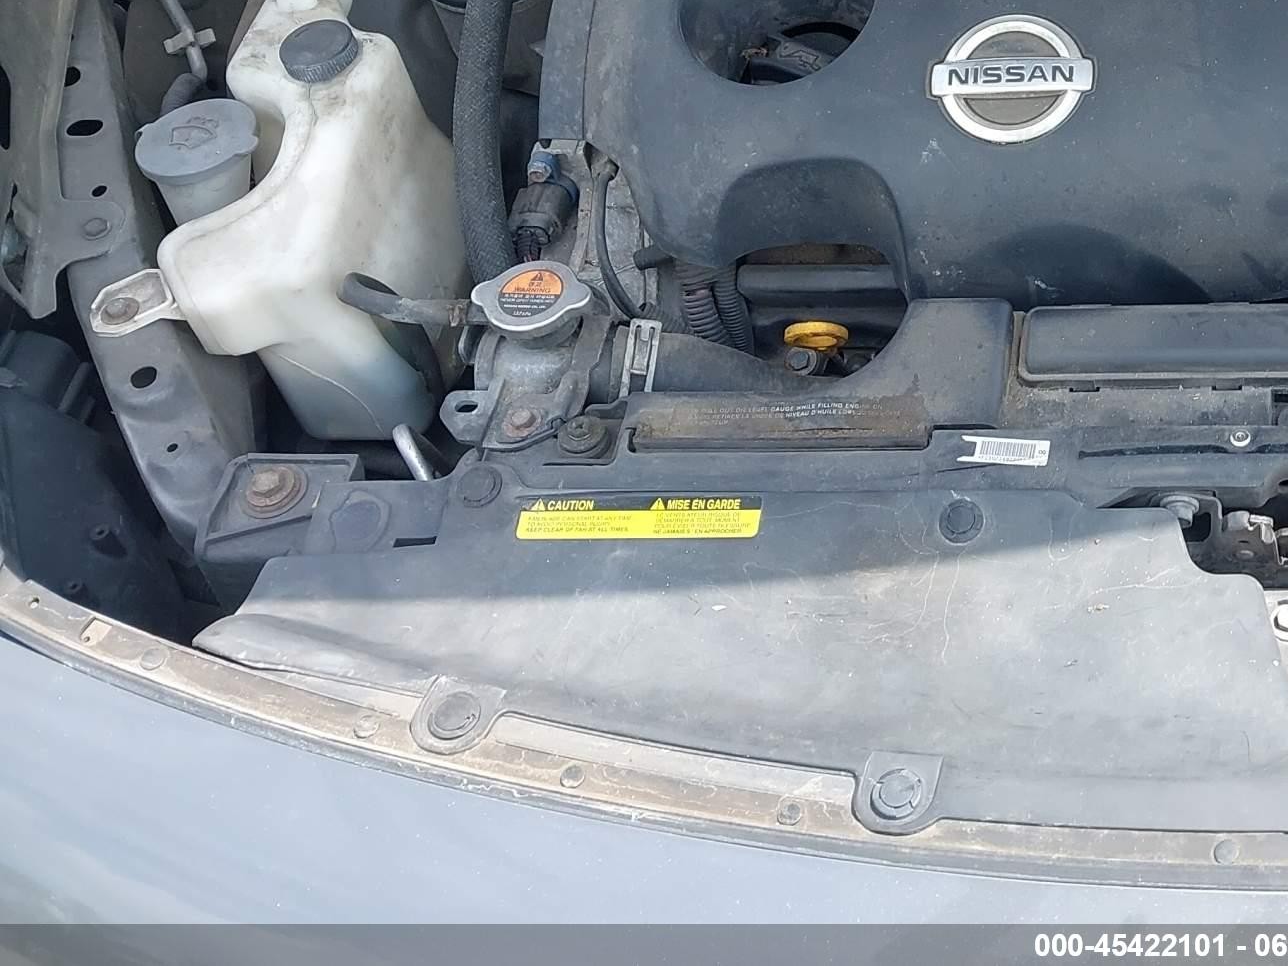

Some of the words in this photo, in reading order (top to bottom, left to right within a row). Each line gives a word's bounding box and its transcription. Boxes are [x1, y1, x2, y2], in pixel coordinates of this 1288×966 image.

[947, 64, 1075, 86] NISSAN
[785, 410, 811, 418] NIVEAU
[547, 500, 594, 511] CAUTION
[666, 499, 691, 510] MISE
[691, 499, 705, 510] EN
[706, 498, 742, 509] GARDE
